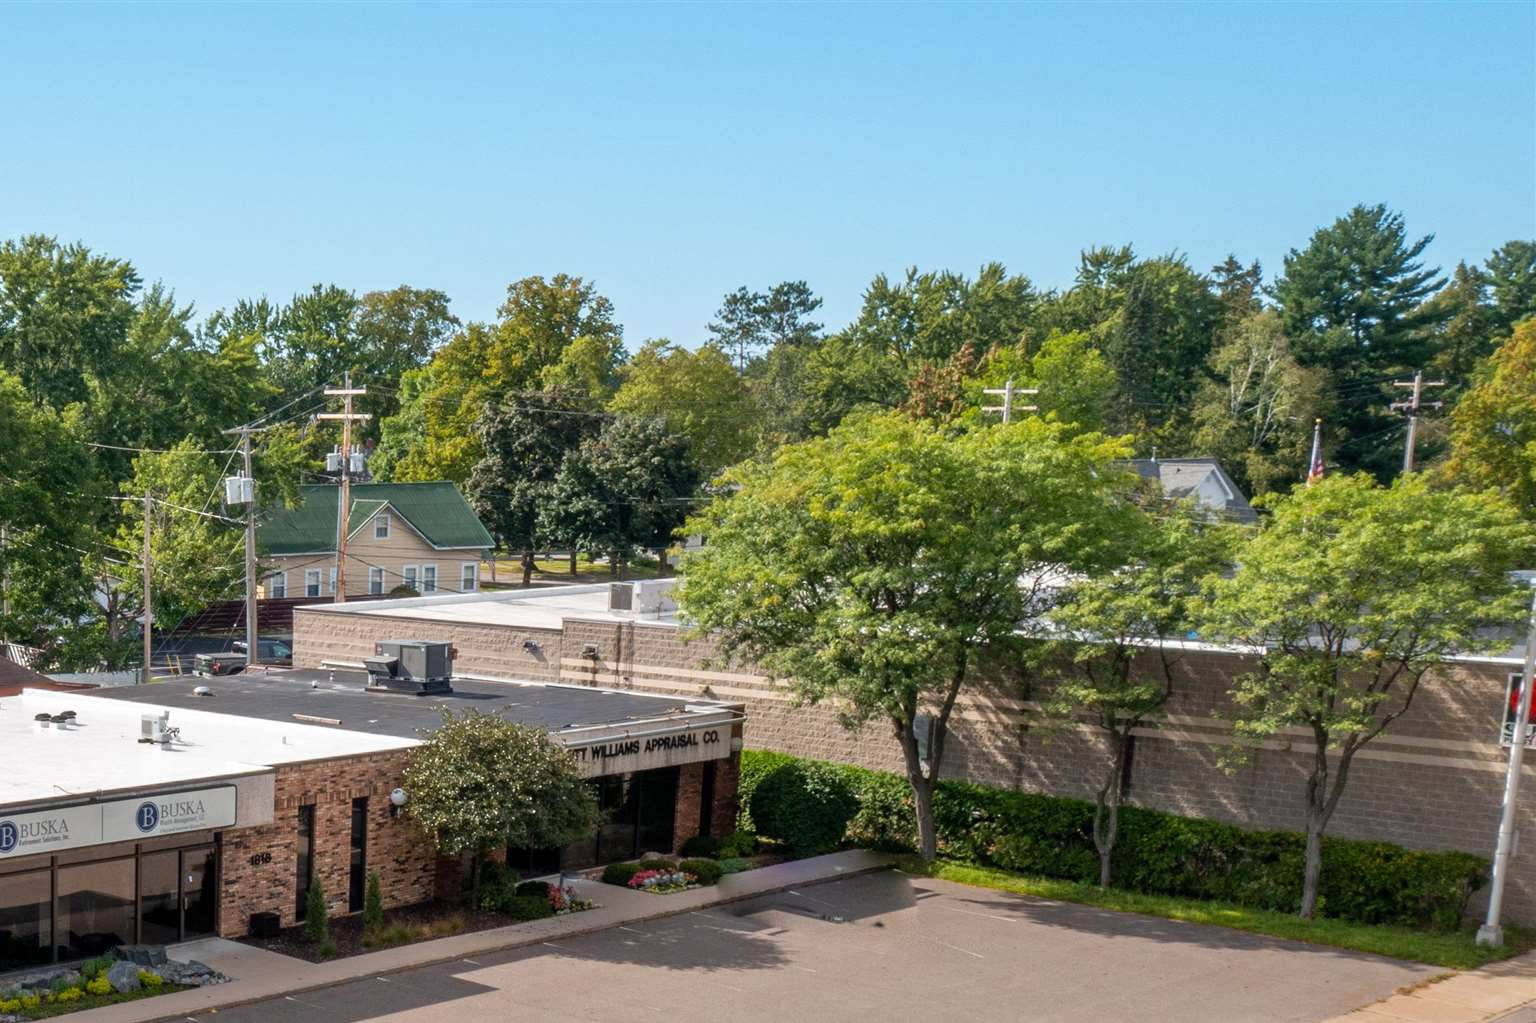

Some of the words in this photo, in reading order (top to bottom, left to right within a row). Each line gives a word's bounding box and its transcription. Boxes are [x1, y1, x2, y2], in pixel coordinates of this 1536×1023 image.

[591, 740, 640, 760] WILLIAMS
[644, 732, 699, 752] APPRAISAL
[703, 730, 720, 744] CO.
[142, 807, 155, 828] B
[161, 799, 205, 818] BUSKA
[0, 826, 14, 848] B
[20, 818, 69, 838] BUSKA
